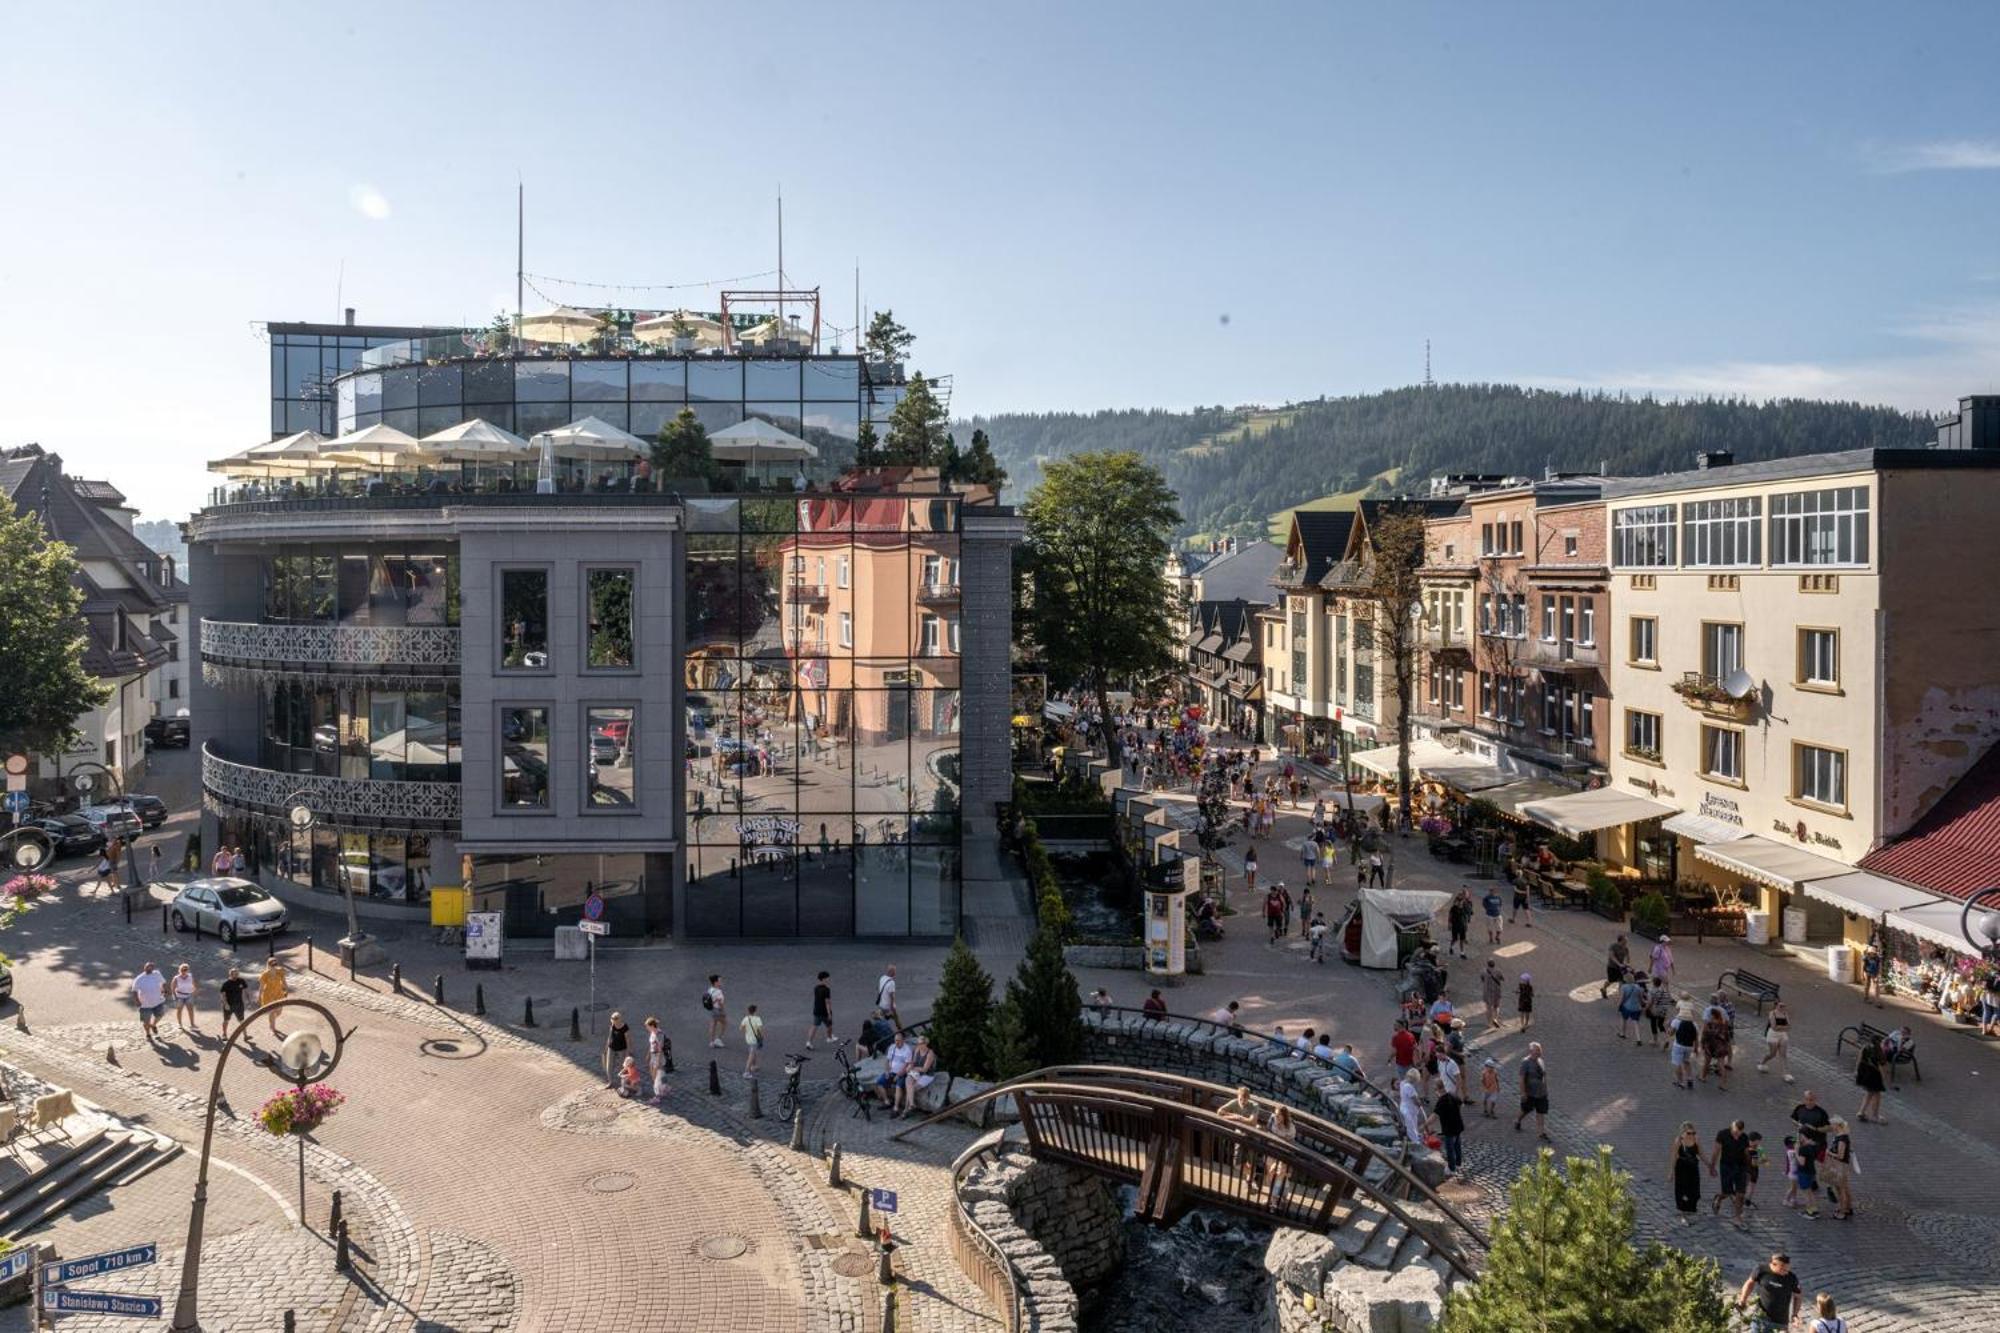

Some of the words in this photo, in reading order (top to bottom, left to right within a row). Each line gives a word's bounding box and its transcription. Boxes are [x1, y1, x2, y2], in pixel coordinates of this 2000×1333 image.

[882, 1191, 890, 1203] P
[68, 1262, 99, 1277] Sopot
[104, 1255, 123, 1269] 710
[126, 1251, 142, 1264] km
[61, 1295, 108, 1310] Stanisława
[111, 1298, 147, 1312] Staszica
